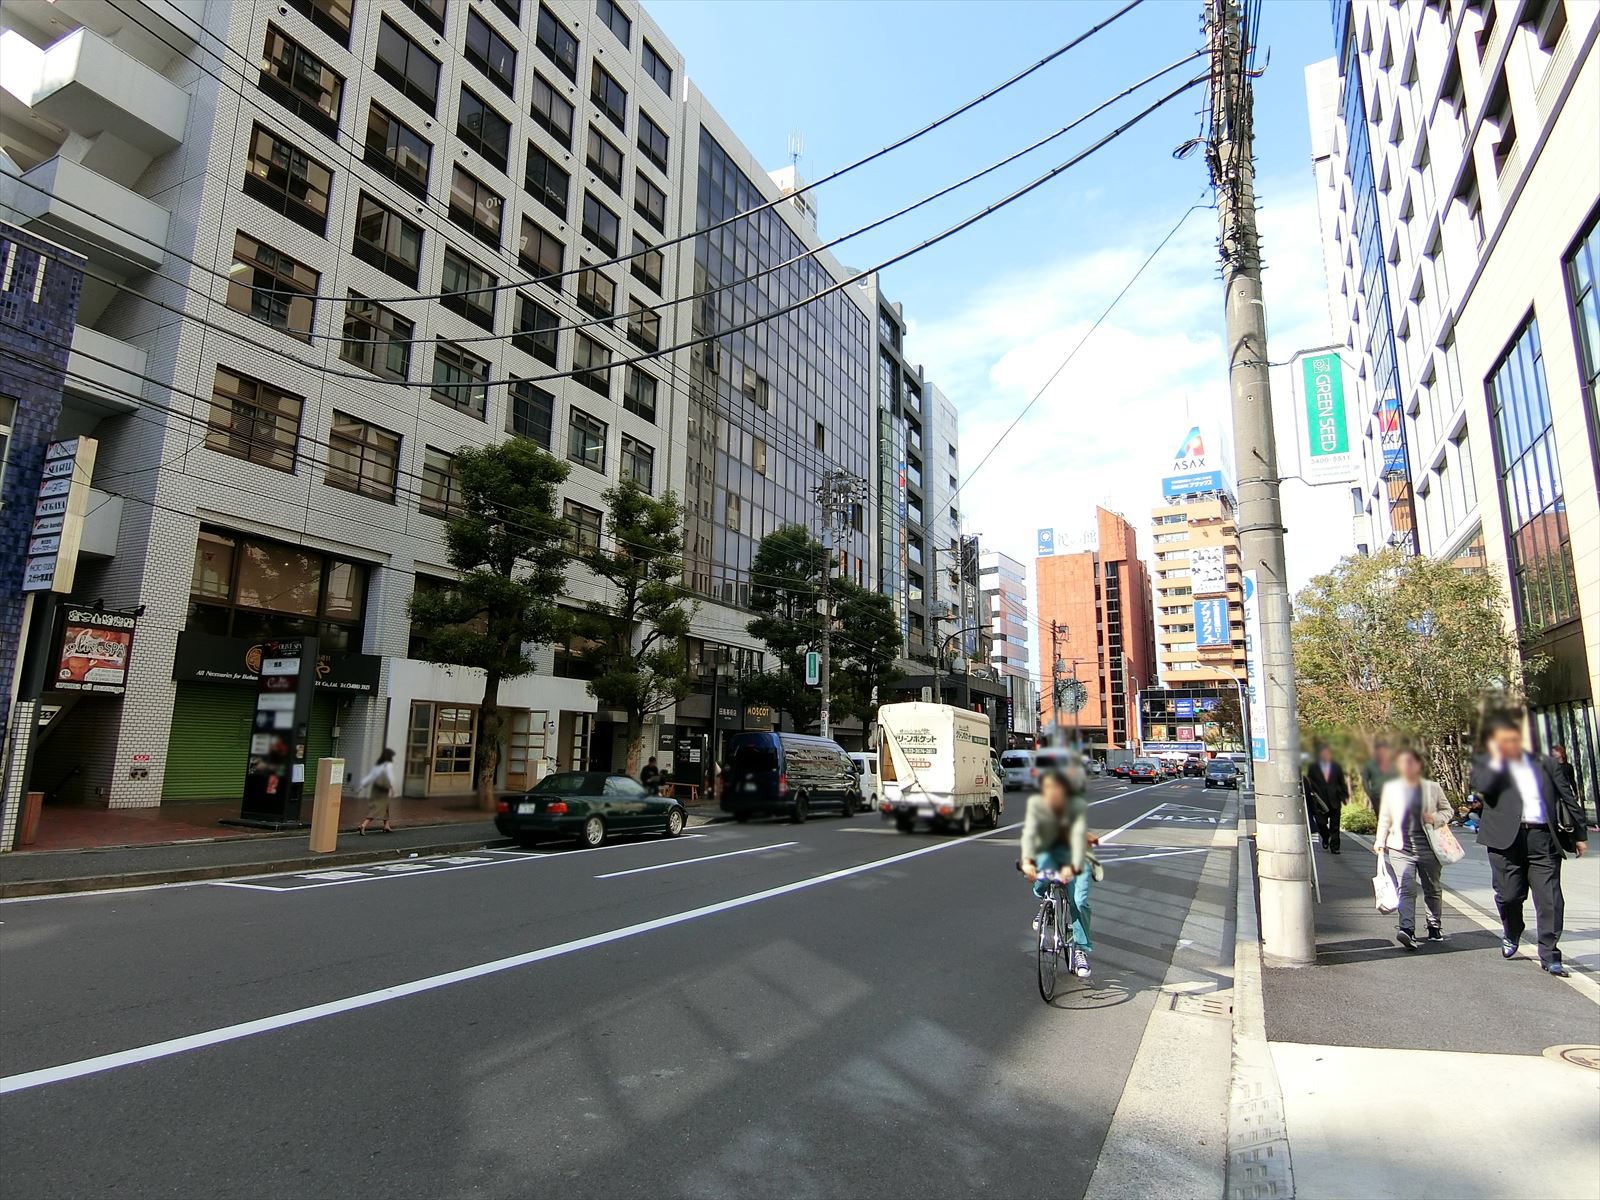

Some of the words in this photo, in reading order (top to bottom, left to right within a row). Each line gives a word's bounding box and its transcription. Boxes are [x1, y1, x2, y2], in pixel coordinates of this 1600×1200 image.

[1315, 374, 1334, 417] GREEN
[1319, 418, 1337, 452] SEED
[1173, 458, 1206, 471] ASAX
[747, 707, 769, 718] MOSCOT
